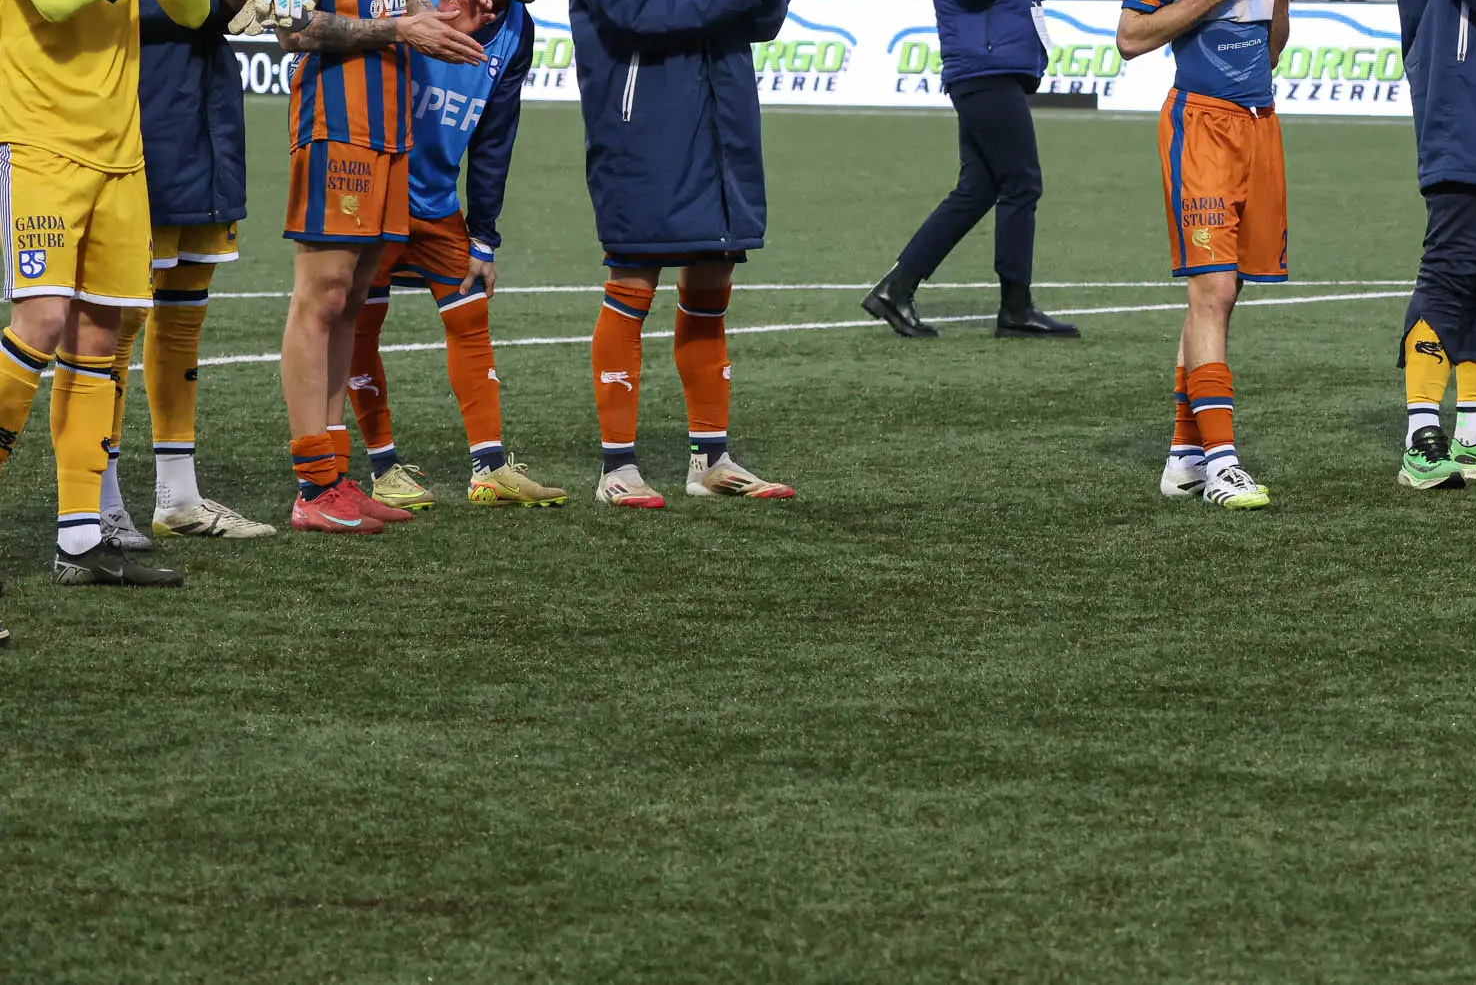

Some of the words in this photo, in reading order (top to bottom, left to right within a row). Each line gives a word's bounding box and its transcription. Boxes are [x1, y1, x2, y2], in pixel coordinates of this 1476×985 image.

[1217, 37, 1263, 52] BRESCIA
[328, 158, 372, 177] GARDA
[327, 176, 371, 193] STUBE
[1181, 196, 1226, 212] GARDA
[15, 215, 66, 232] GARDA
[1183, 212, 1225, 227] STUBE
[17, 233, 65, 249] STUBE
